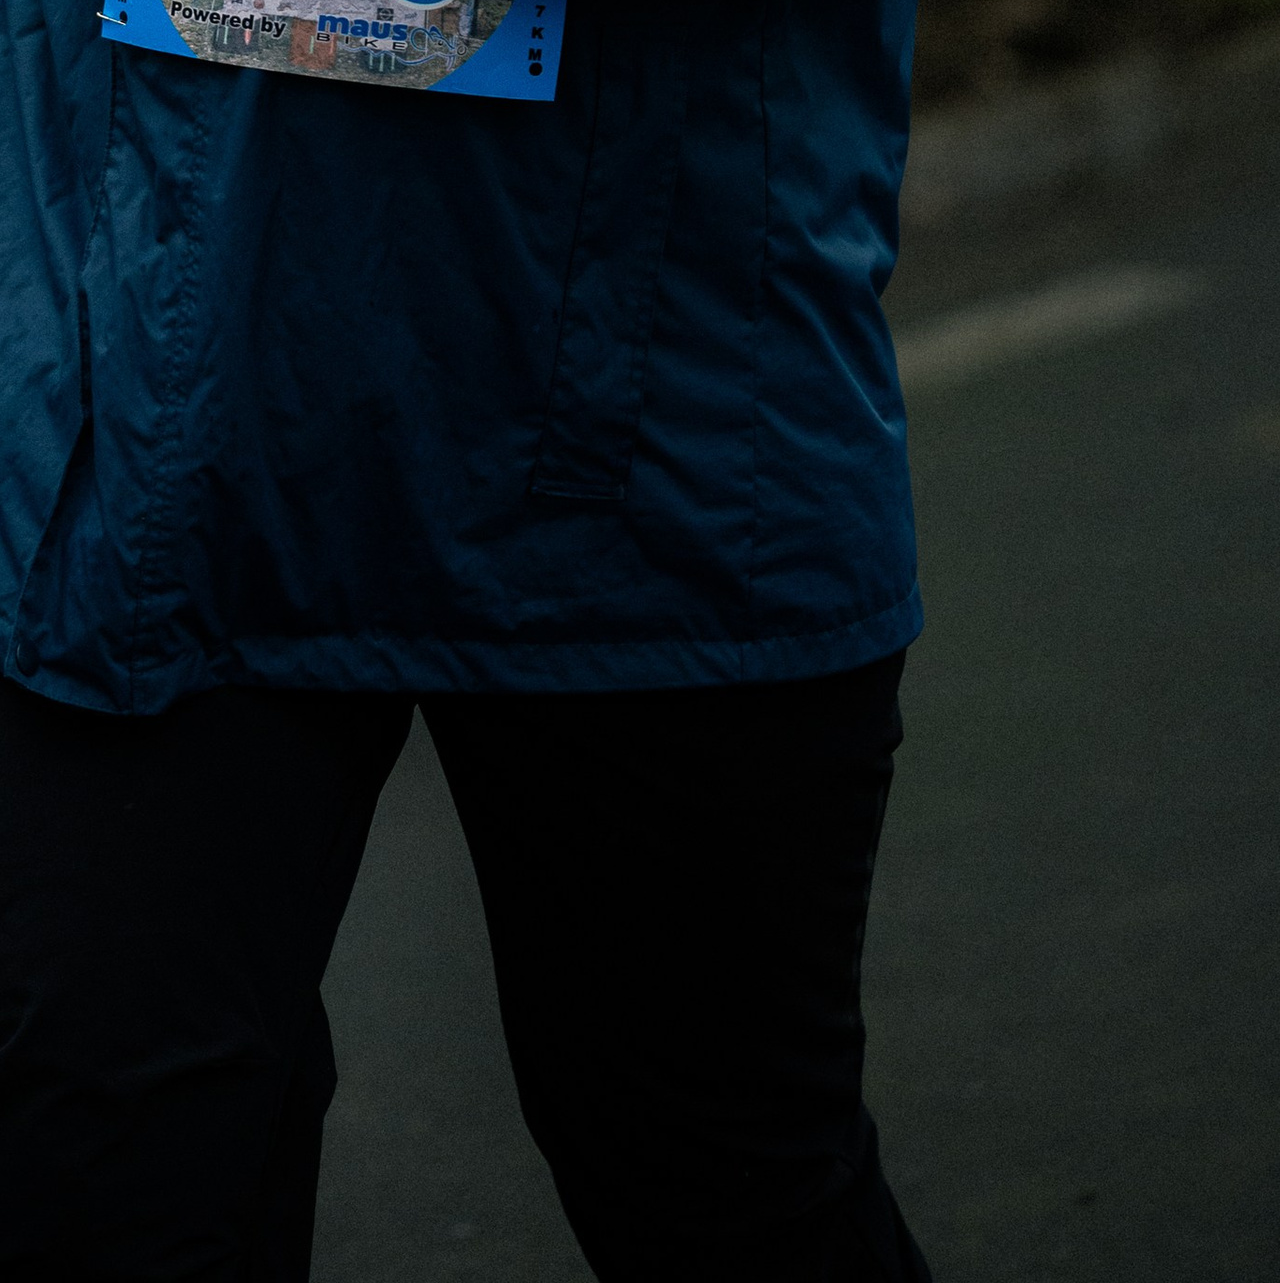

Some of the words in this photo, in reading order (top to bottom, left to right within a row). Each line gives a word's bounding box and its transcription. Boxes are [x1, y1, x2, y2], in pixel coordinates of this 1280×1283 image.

[171, 1, 255, 32] Powered
[261, 13, 286, 37] by
[318, 14, 407, 41] maus
[317, 32, 407, 51] BIKE
